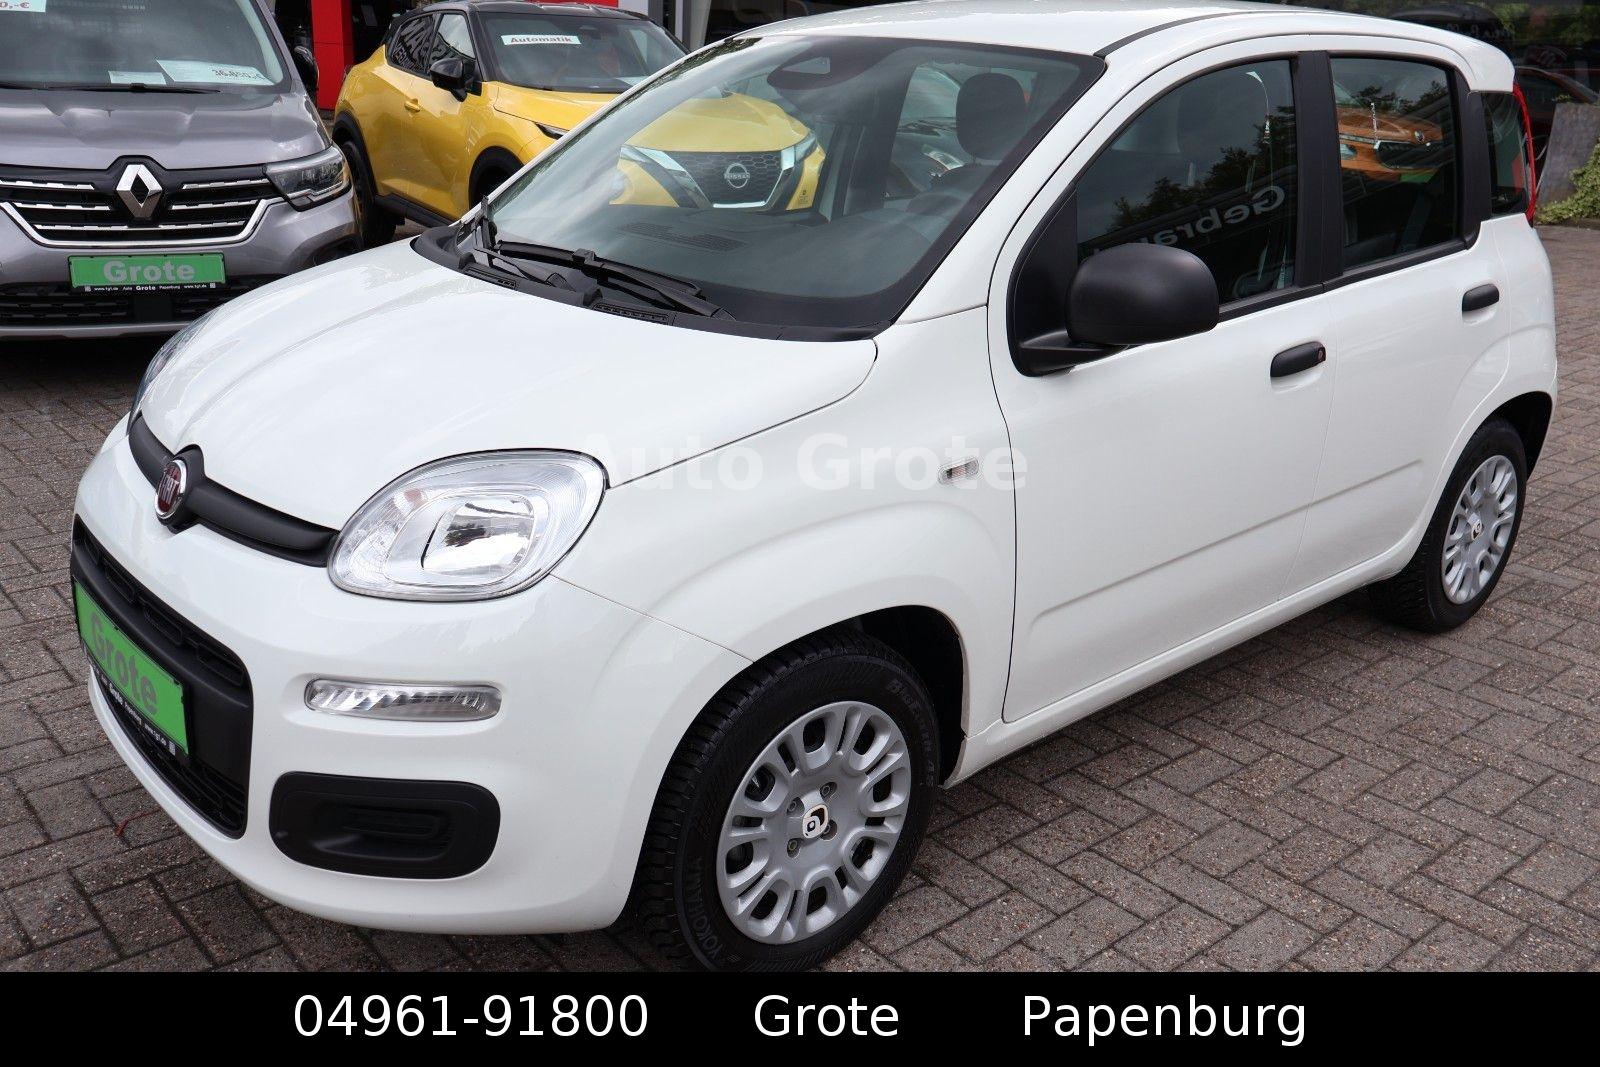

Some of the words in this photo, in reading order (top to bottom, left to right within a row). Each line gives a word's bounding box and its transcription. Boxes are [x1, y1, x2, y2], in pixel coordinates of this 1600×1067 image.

[103, 260, 195, 282] Grote
[157, 471, 180, 505] FIAT
[90, 612, 158, 716] Grote
[686, 857, 723, 960] YOKOHAMA
